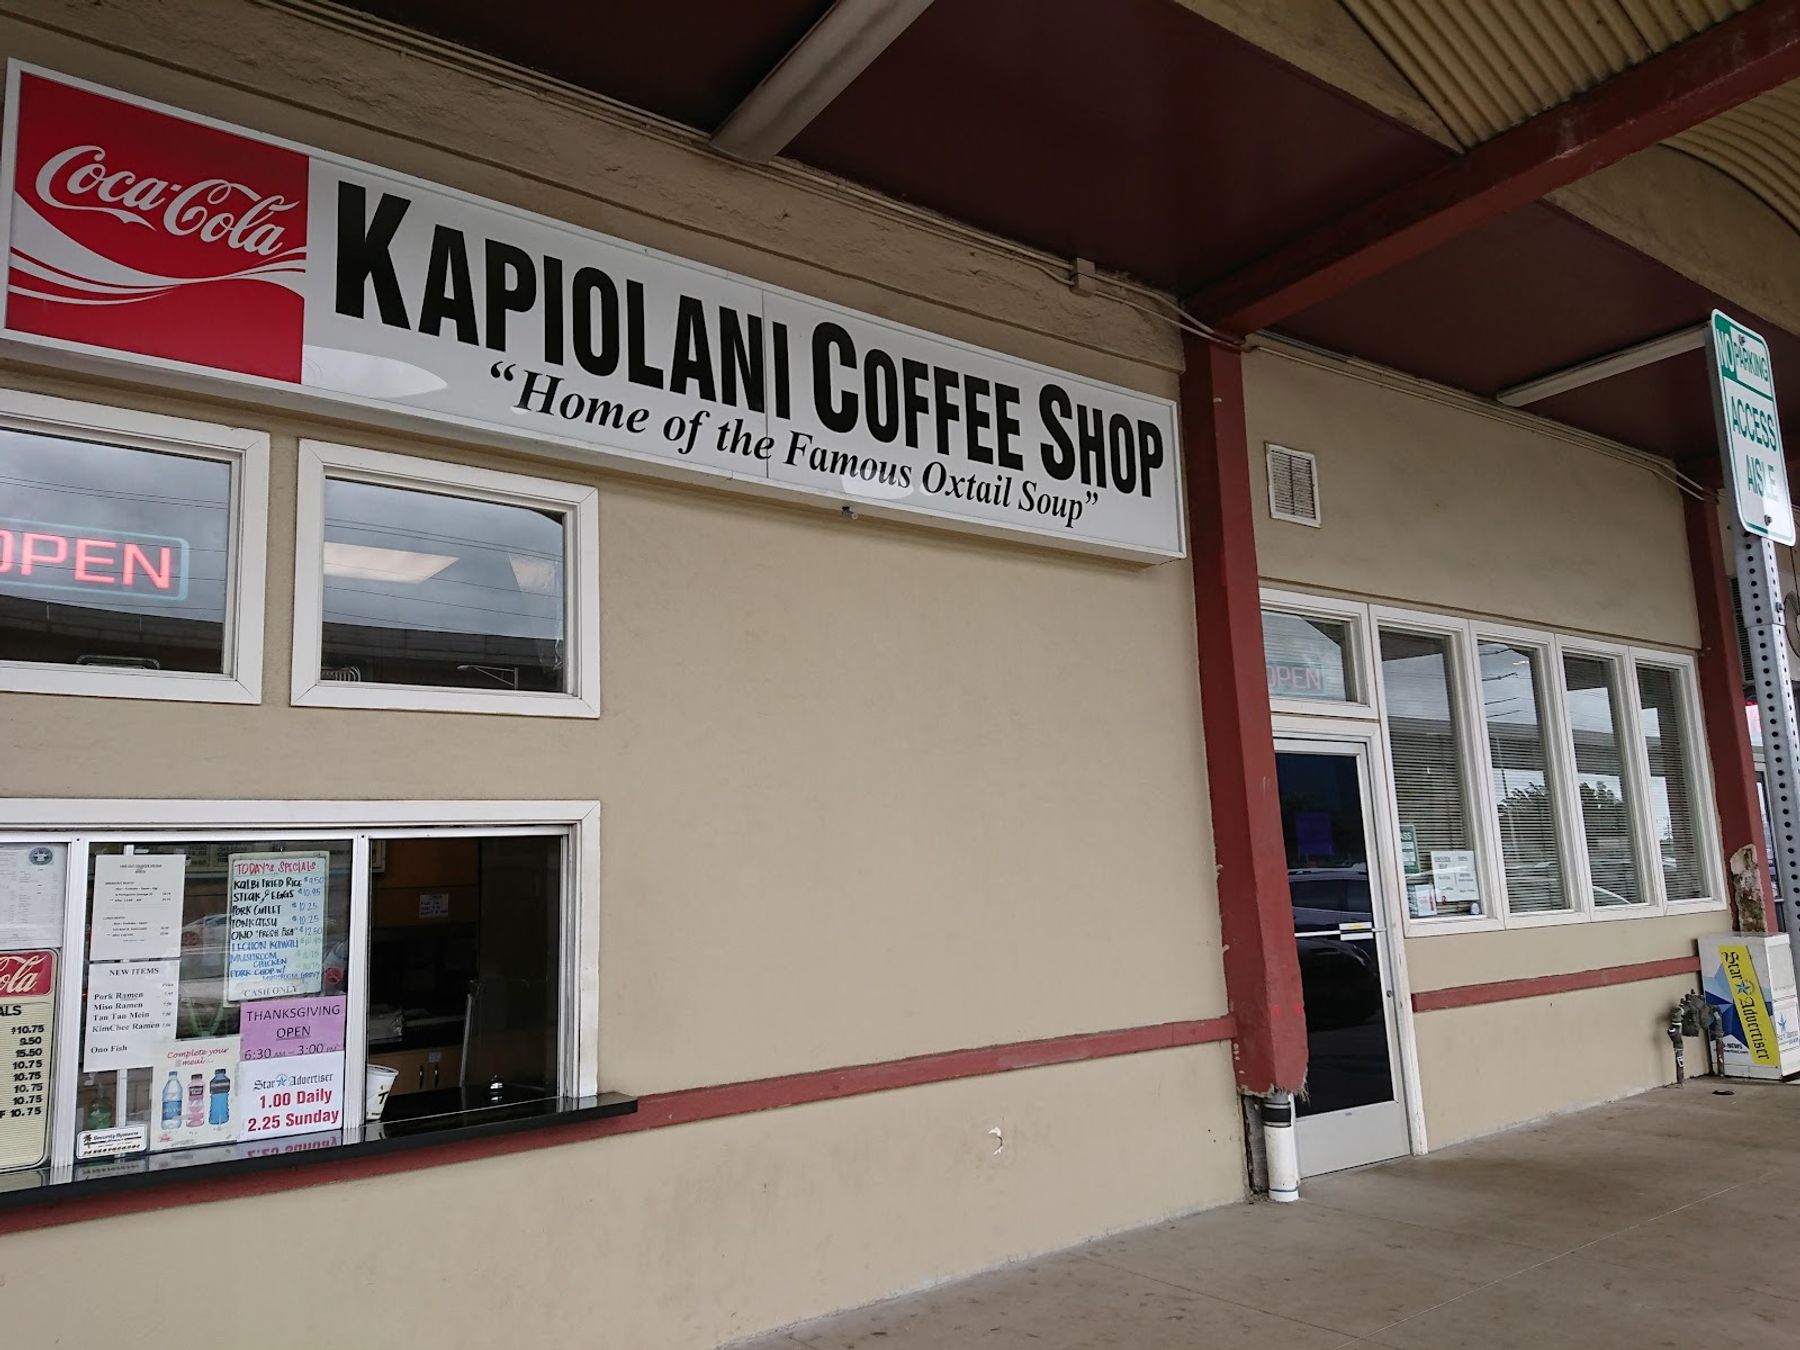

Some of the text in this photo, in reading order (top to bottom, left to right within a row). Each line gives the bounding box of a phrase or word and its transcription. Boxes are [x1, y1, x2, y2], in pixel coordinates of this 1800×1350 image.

[36, 144, 300, 256] Coca-Cola
[335, 180, 1164, 498] KAPIOLANI COFFEE SHOP
[1716, 328, 1769, 382] NO PARKING
[1731, 396, 1777, 452] ACCESS
[663, 410, 711, 455] of
[716, 418, 775, 460] the
[784, 429, 912, 489] Famous
[922, 461, 1012, 509] Oxtail
[1746, 454, 1778, 501] AISLE
[0, 529, 172, 589] PEN
[231, 931, 253, 941] ONO
[253, 958, 287, 968] CHICKEN
[109, 967, 160, 977] NEW ITEMS
[94, 992, 144, 1001] Pork Ramen
[244, 985, 297, 997] CASH ONLY
[94, 1002, 143, 1011] Miso Ramen
[1722, 951, 1770, 1060] Star Advertiser
[246, 1004, 341, 1022] THANKSGIVING
[132, 1022, 160, 1030] Ramen
[276, 1025, 311, 1039] OPEN
[91, 1045, 128, 1054] Ono Fish
[167, 1047, 229, 1060] Complete your
[244, 1048, 272, 1061] 6:30
[297, 1043, 324, 1056] 3:00
[13, 1060, 43, 1070] 10.75
[13, 1071, 42, 1081] 10.75
[254, 1073, 334, 1091] Star Advertiser
[14, 1083, 43, 1093] 10.75
[13, 1094, 42, 1105] 10.75
[260, 1088, 333, 1109] 1.00 Daily
[10, 1106, 42, 1117] 10.75
[247, 1109, 340, 1132] 2.25 Sunday
